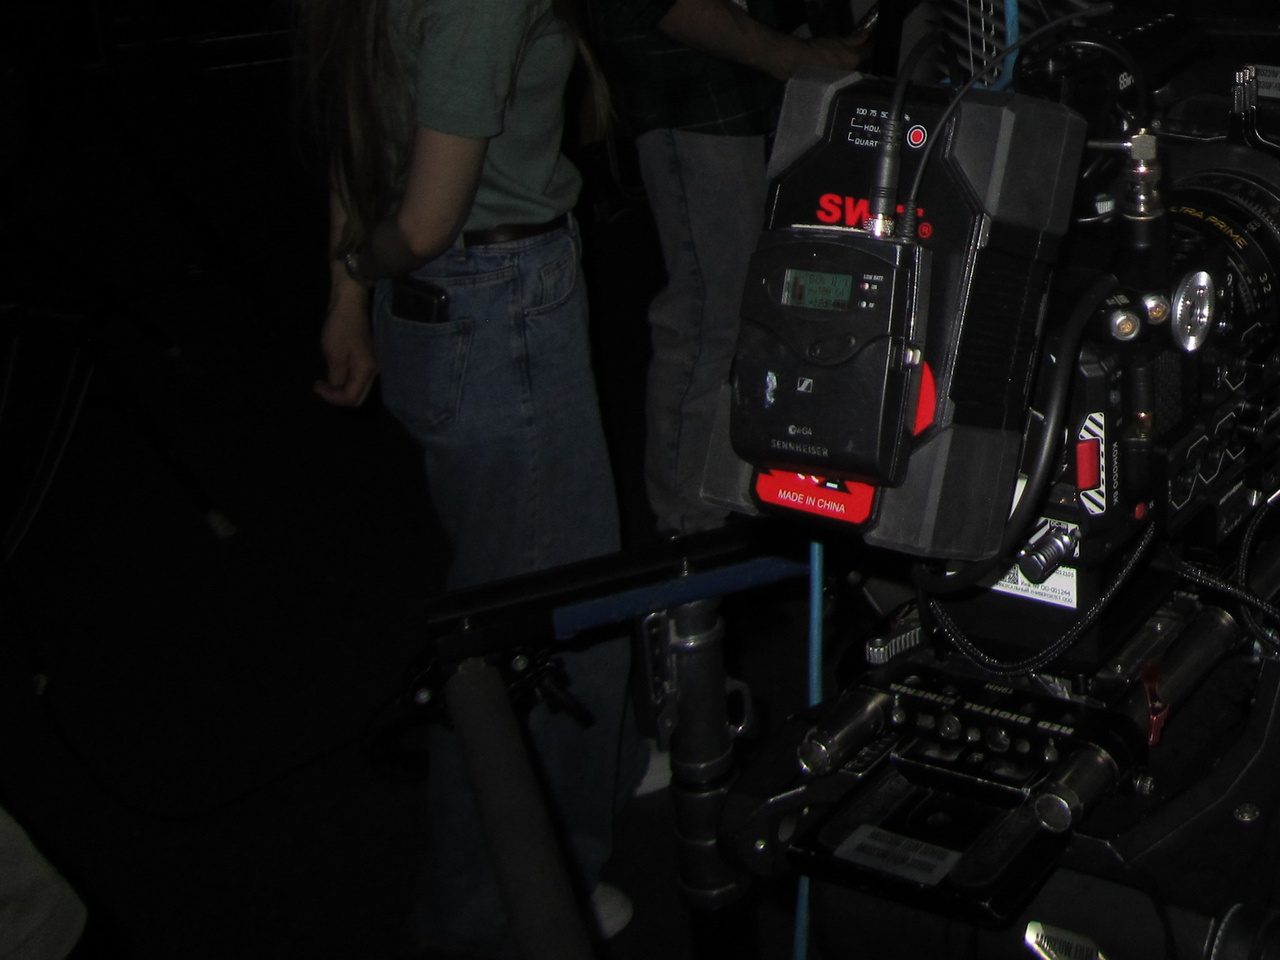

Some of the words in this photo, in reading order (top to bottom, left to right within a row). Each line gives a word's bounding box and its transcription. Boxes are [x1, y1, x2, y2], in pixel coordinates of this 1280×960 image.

[855, 106, 868, 116] 100
[868, 108, 878, 117] 75
[1205, 216, 1249, 250] PRIME
[770, 438, 830, 458] SENNHEISER
[1111, 441, 1120, 489] KOMODO
[778, 488, 804, 505] MADE
[805, 494, 816, 506] IN
[817, 496, 846, 514] CHINA
[889, 682, 958, 706] CINEMA
[963, 700, 1032, 726] DIGITAL
[1036, 719, 1076, 736] RED
